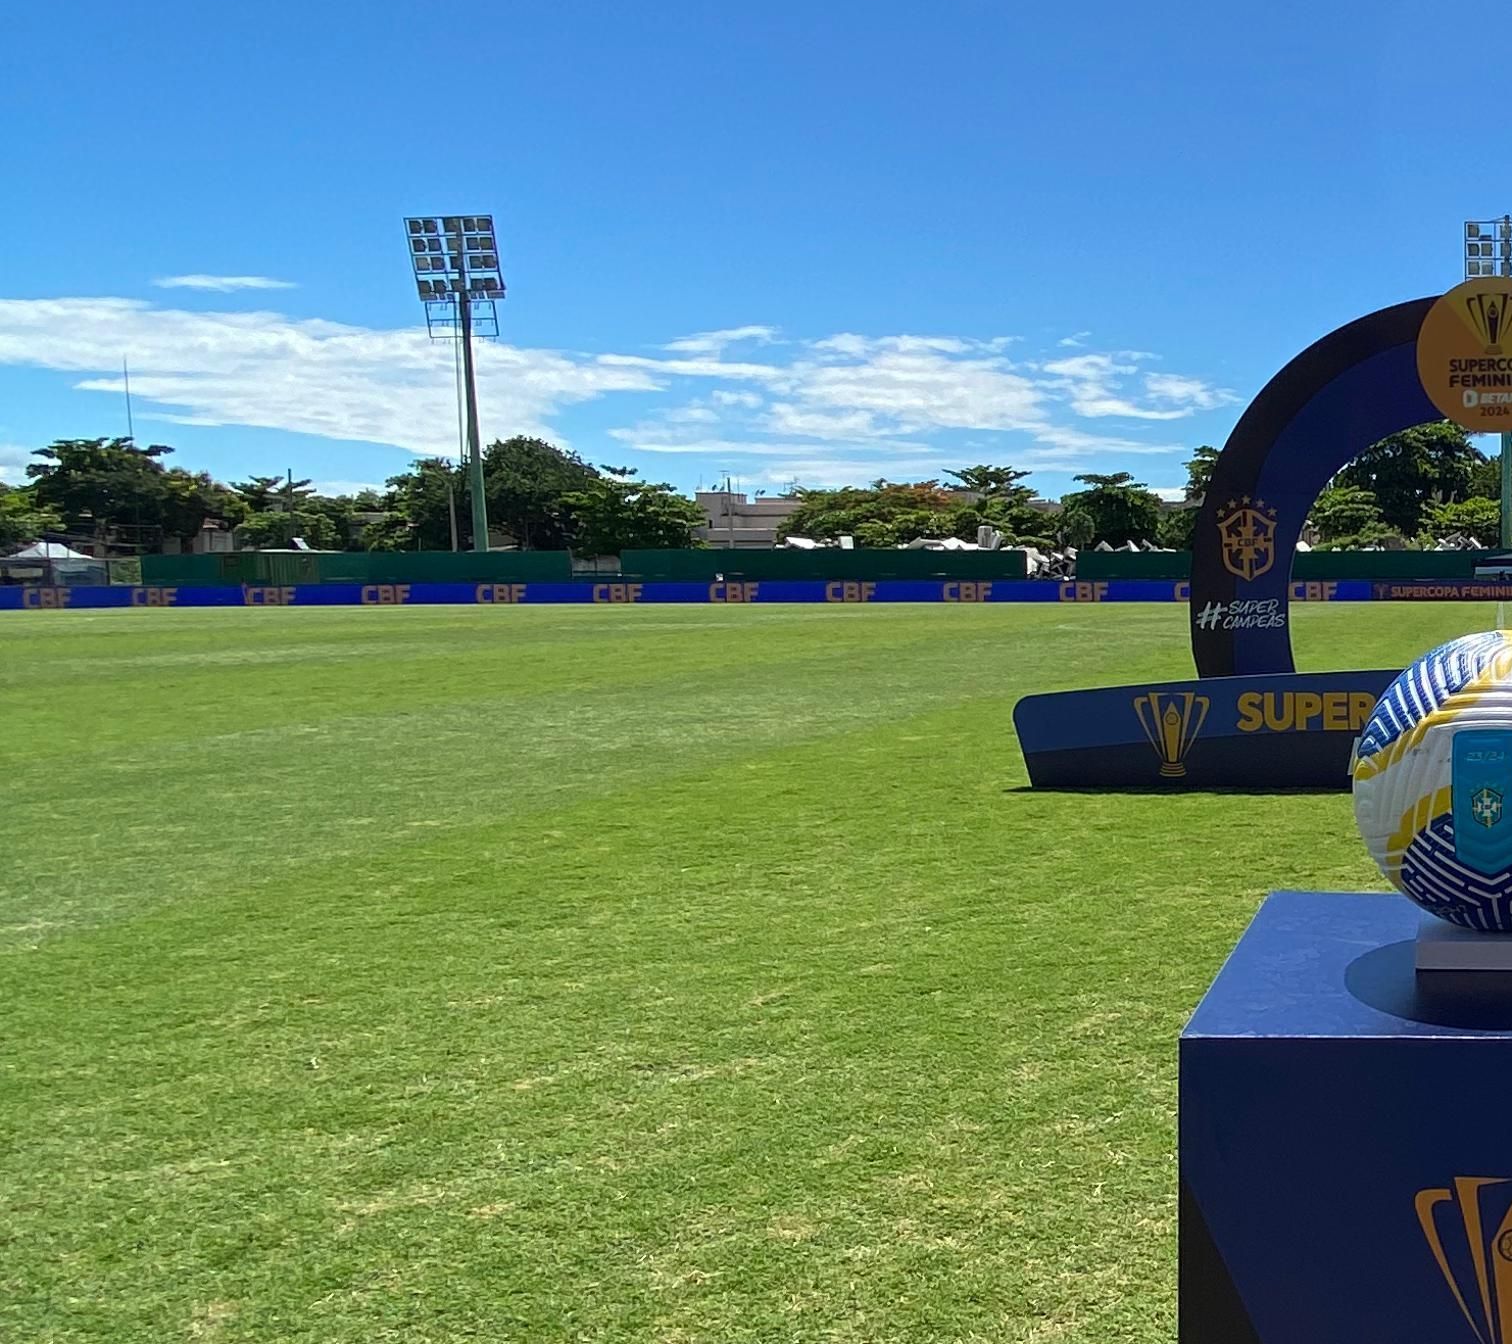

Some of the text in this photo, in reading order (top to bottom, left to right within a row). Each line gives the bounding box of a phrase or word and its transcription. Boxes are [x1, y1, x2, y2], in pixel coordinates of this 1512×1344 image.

[1480, 406, 1510, 417] 2024
[22, 587, 72, 609] CBF
[131, 587, 178, 607] CBF
[247, 586, 297, 606] CBF
[361, 585, 411, 604] CBF
[475, 584, 527, 603] CBF
[593, 584, 643, 603] CBF
[709, 582, 759, 602] CBF
[826, 582, 877, 602] CBF
[943, 582, 993, 602] CBF
[1059, 582, 1109, 602] CBF
[1288, 581, 1337, 601] CBF
[1391, 585, 1460, 598] SUPERCOPA
[1236, 692, 1376, 732] SUPER
